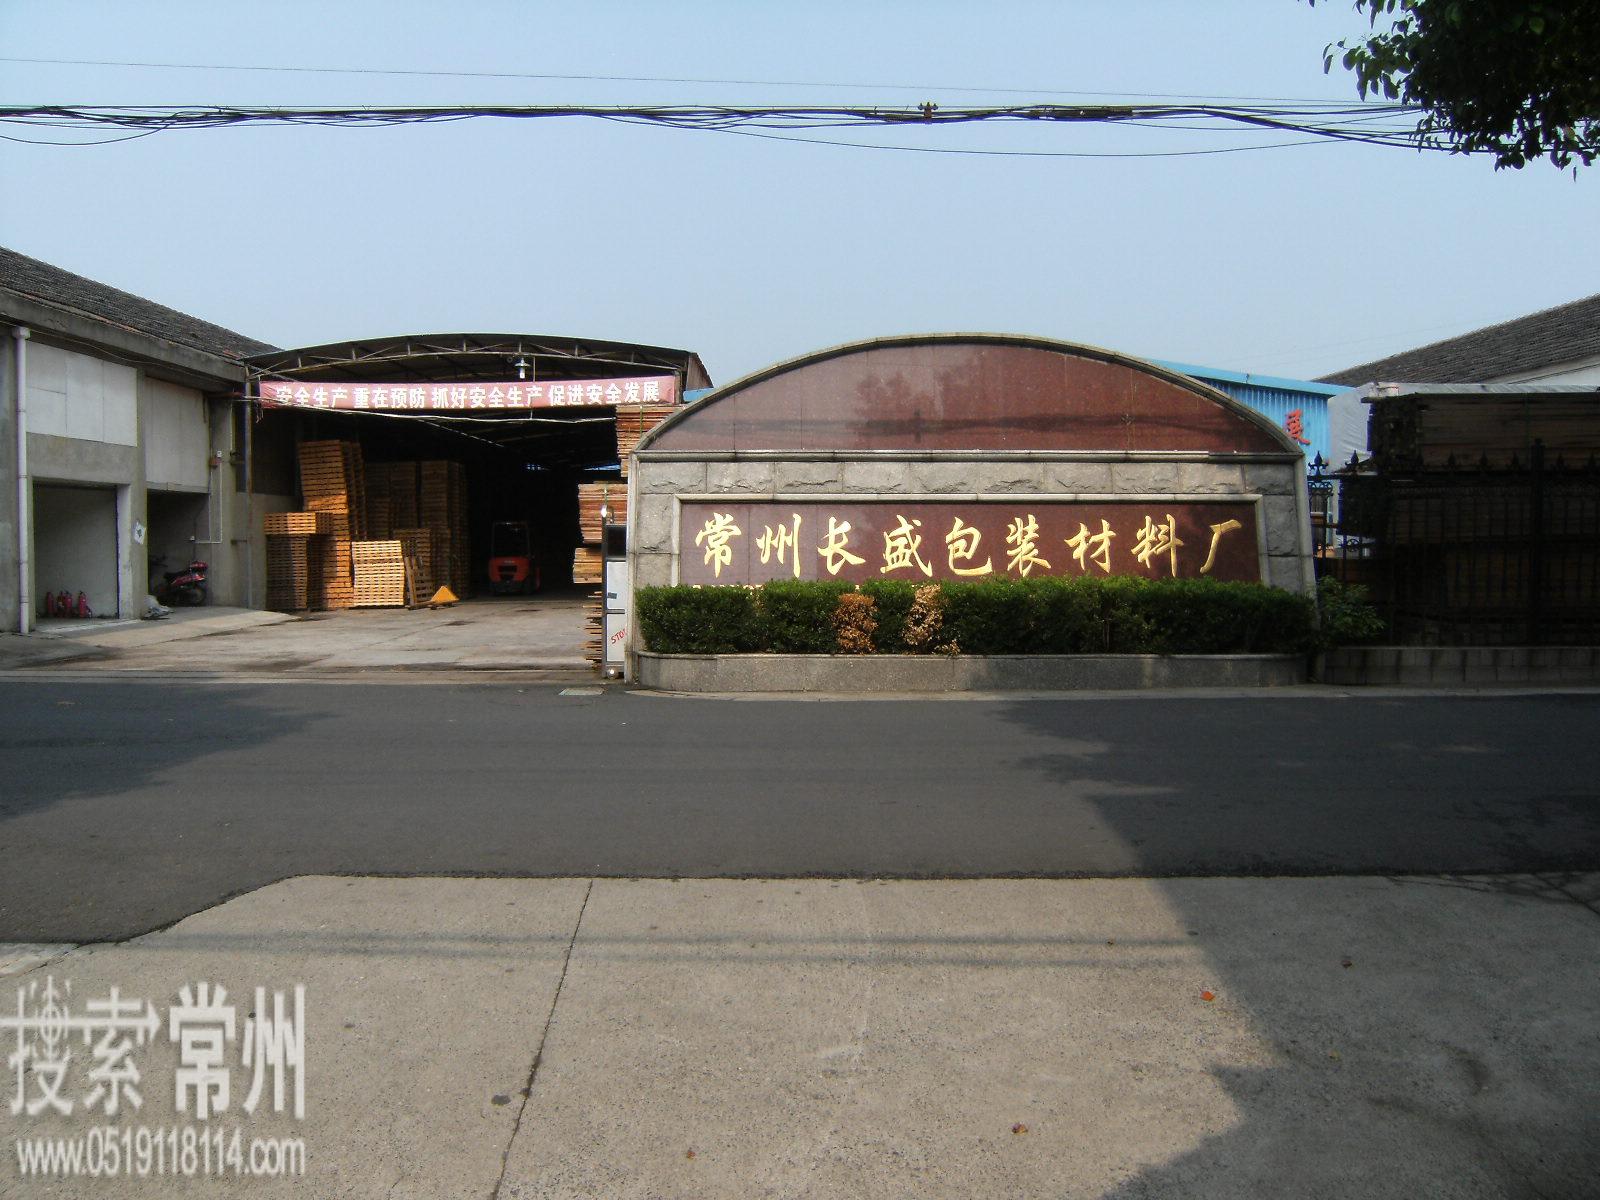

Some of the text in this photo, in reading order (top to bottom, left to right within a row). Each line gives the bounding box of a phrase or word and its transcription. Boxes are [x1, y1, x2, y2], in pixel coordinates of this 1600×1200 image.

[276, 381, 660, 409] 安全生产 重在预防 抓好安全生产 促进安全发展
[695, 512, 1241, 578] 常州长盛包装材料厂
[611, 627, 627, 645] STO
